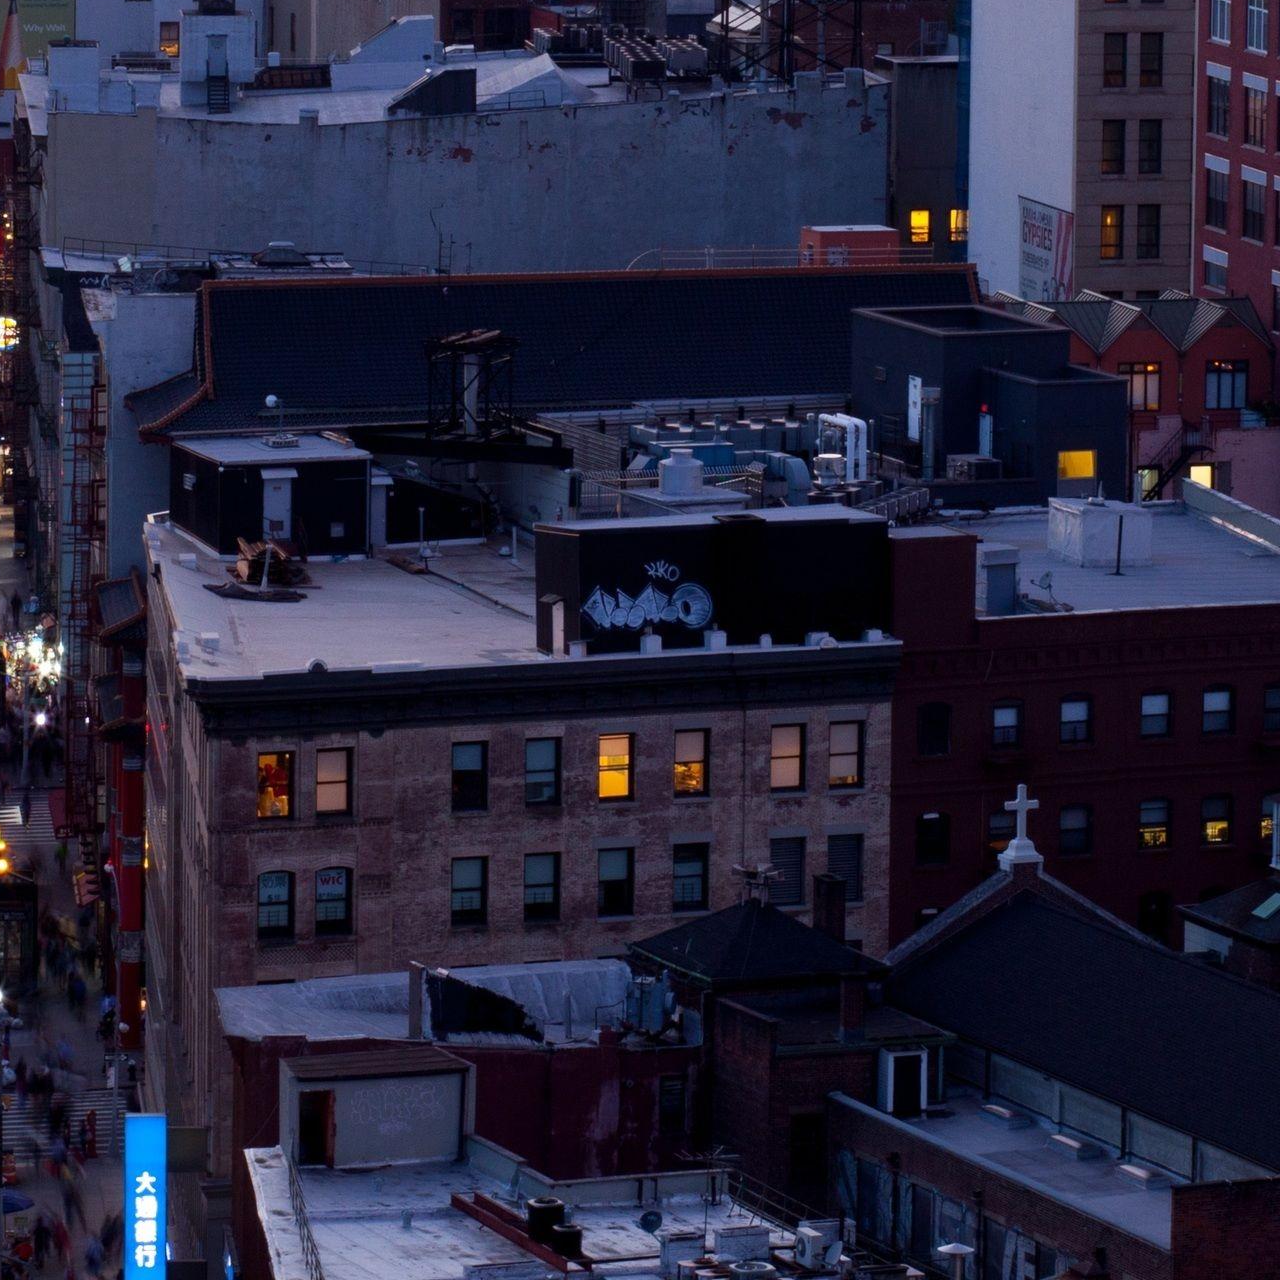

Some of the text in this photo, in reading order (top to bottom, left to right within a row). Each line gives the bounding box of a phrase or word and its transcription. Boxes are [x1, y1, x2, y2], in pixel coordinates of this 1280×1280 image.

[23, 23, 67, 34] Why Wait
[1022, 220, 1053, 251] GYPSIES
[320, 875, 343, 886] WIC
